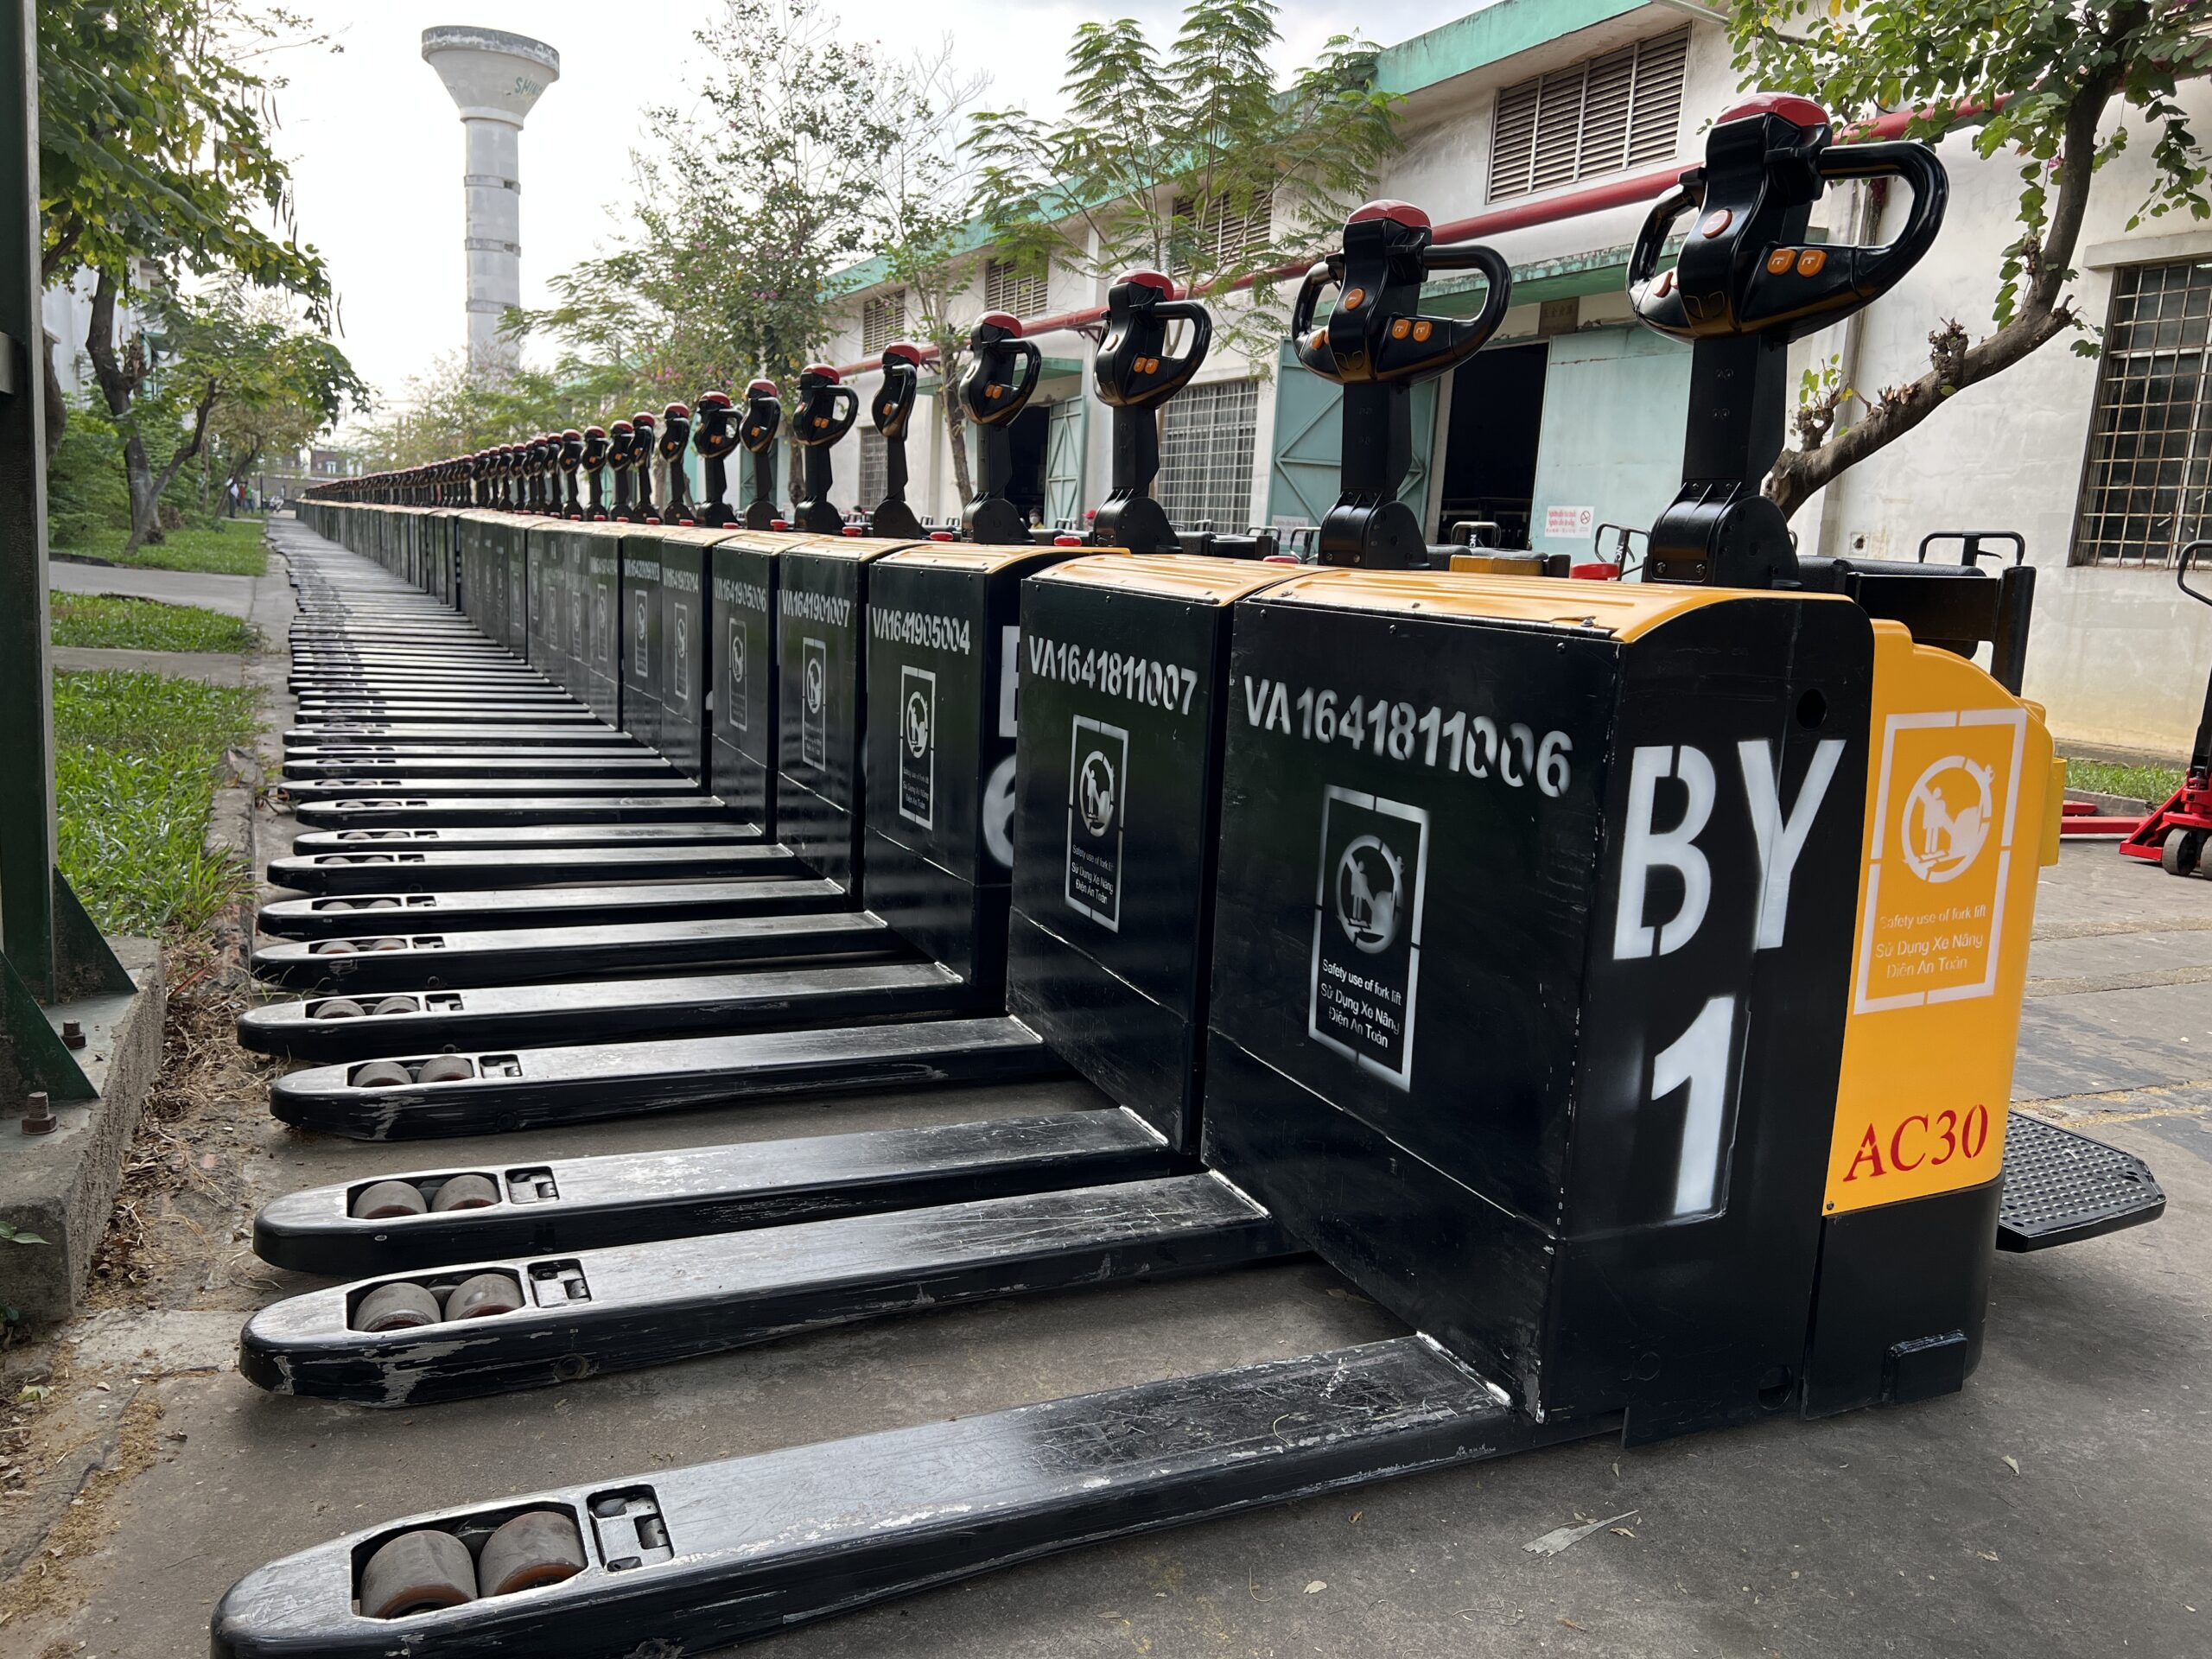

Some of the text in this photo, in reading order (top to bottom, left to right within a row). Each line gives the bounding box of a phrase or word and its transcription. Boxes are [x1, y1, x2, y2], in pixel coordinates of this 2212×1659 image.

[782, 588, 850, 627] VA1641901007
[872, 607, 970, 654] VA1641905004
[1029, 635, 1198, 715] VA1641811007
[1613, 739, 1847, 960] BY
[1879, 904, 1986, 930] Safety use of fork lift
[1933, 936, 1949, 951] Xe
[1952, 933, 1983, 949] Nâng
[1322, 958, 1402, 1006] Safety use of fork lift
[1916, 960, 1935, 975] An
[1350, 1018, 1363, 1035] An
[1361, 1000, 1374, 1019] Xe
[1651, 995, 1734, 1214] 1
[1842, 1103, 1988, 1183] AC30
